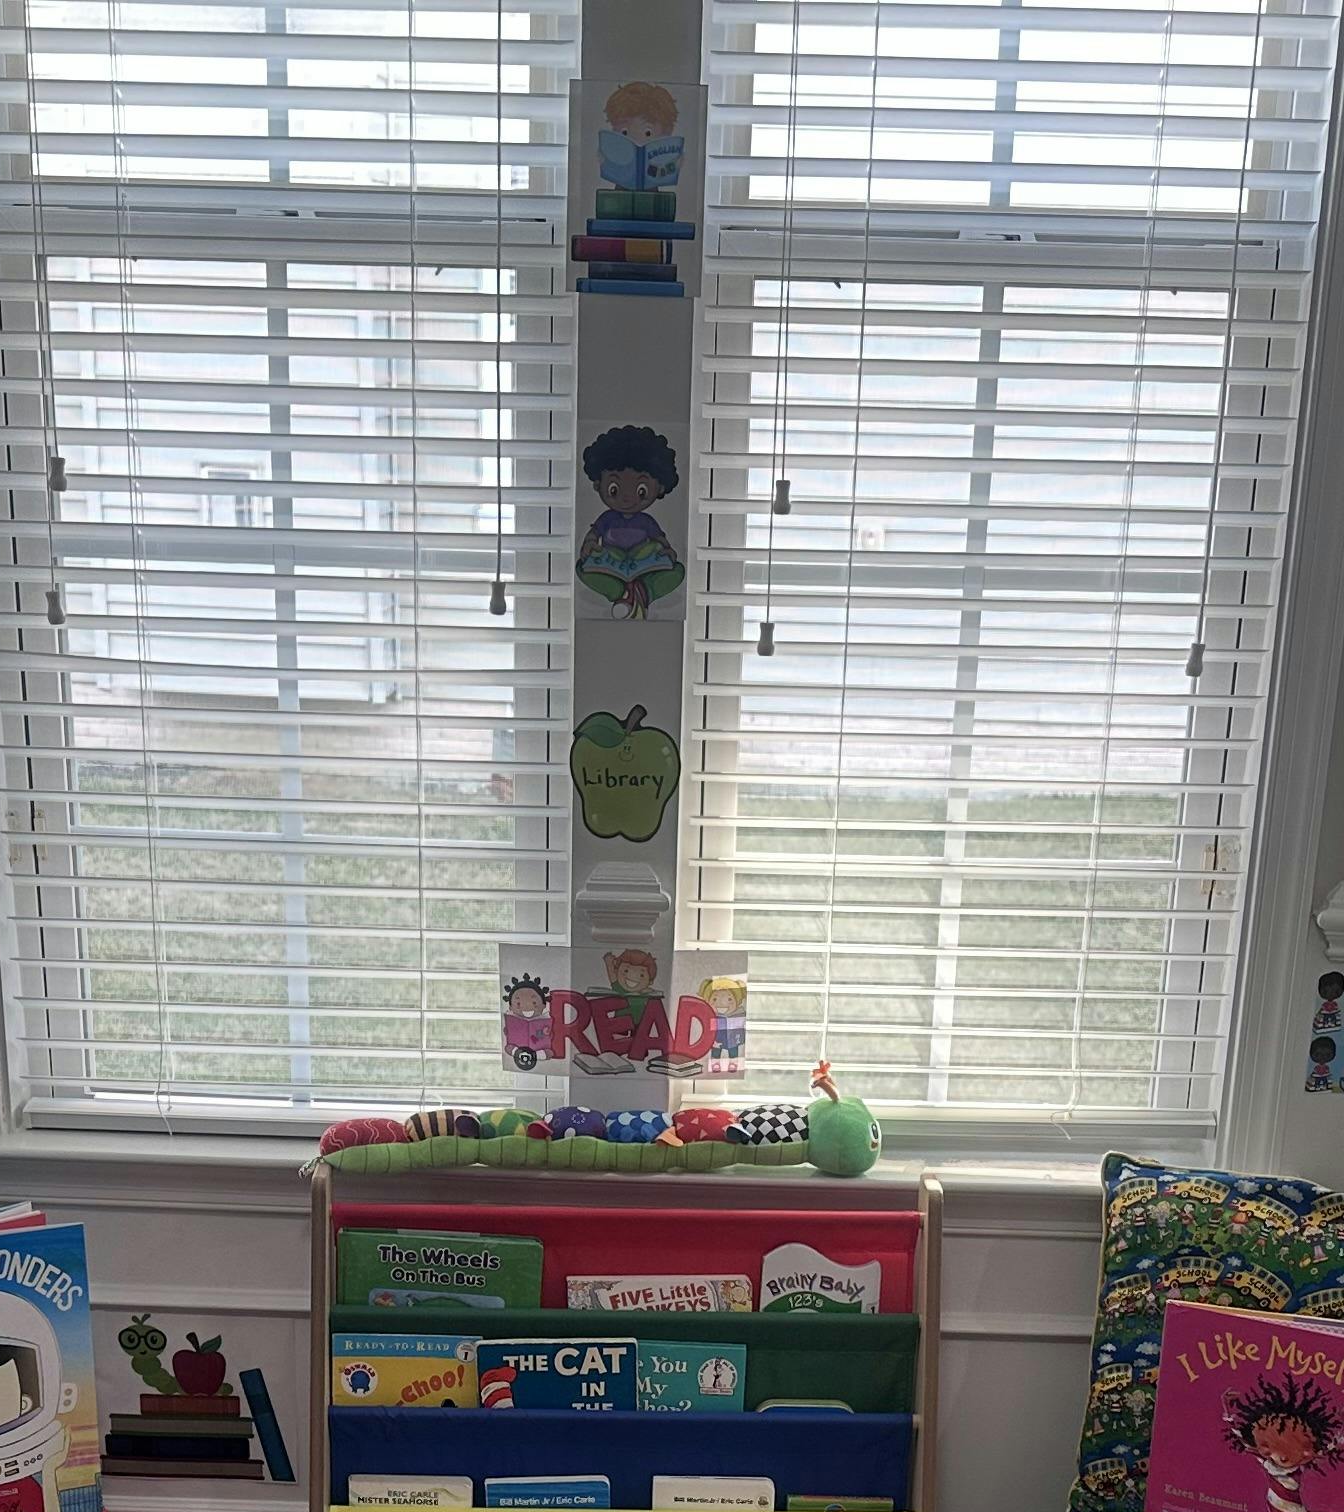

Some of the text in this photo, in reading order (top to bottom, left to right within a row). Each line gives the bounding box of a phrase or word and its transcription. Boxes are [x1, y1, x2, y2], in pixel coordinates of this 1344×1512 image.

[582, 769, 664, 801] Library
[549, 989, 717, 1062] READ
[1121, 1187, 1155, 1203] SCHOOL
[1189, 1186, 1221, 1199] SCHOOL
[1254, 1205, 1287, 1224] SCHOOL
[378, 1245, 501, 1269] The Wheels
[391, 1268, 486, 1287] On The Bus
[1176, 1269, 1212, 1278] SCHOOL
[766, 1272, 865, 1301] Brainy Baby
[1248, 1278, 1280, 1303] SCHOOL
[609, 1283, 707, 1311] FIVE Little
[788, 1294, 824, 1308] 123's
[503, 1355, 548, 1372] THE
[554, 1347, 627, 1376] CAT
[652, 1357, 688, 1374] You
[1176, 1353, 1200, 1382] I
[1197, 1332, 1261, 1370] Like
[582, 1382, 605, 1397] IN
[1101, 1373, 1129, 1388] SCHOOL
[556, 1496, 572, 1504] Eric
